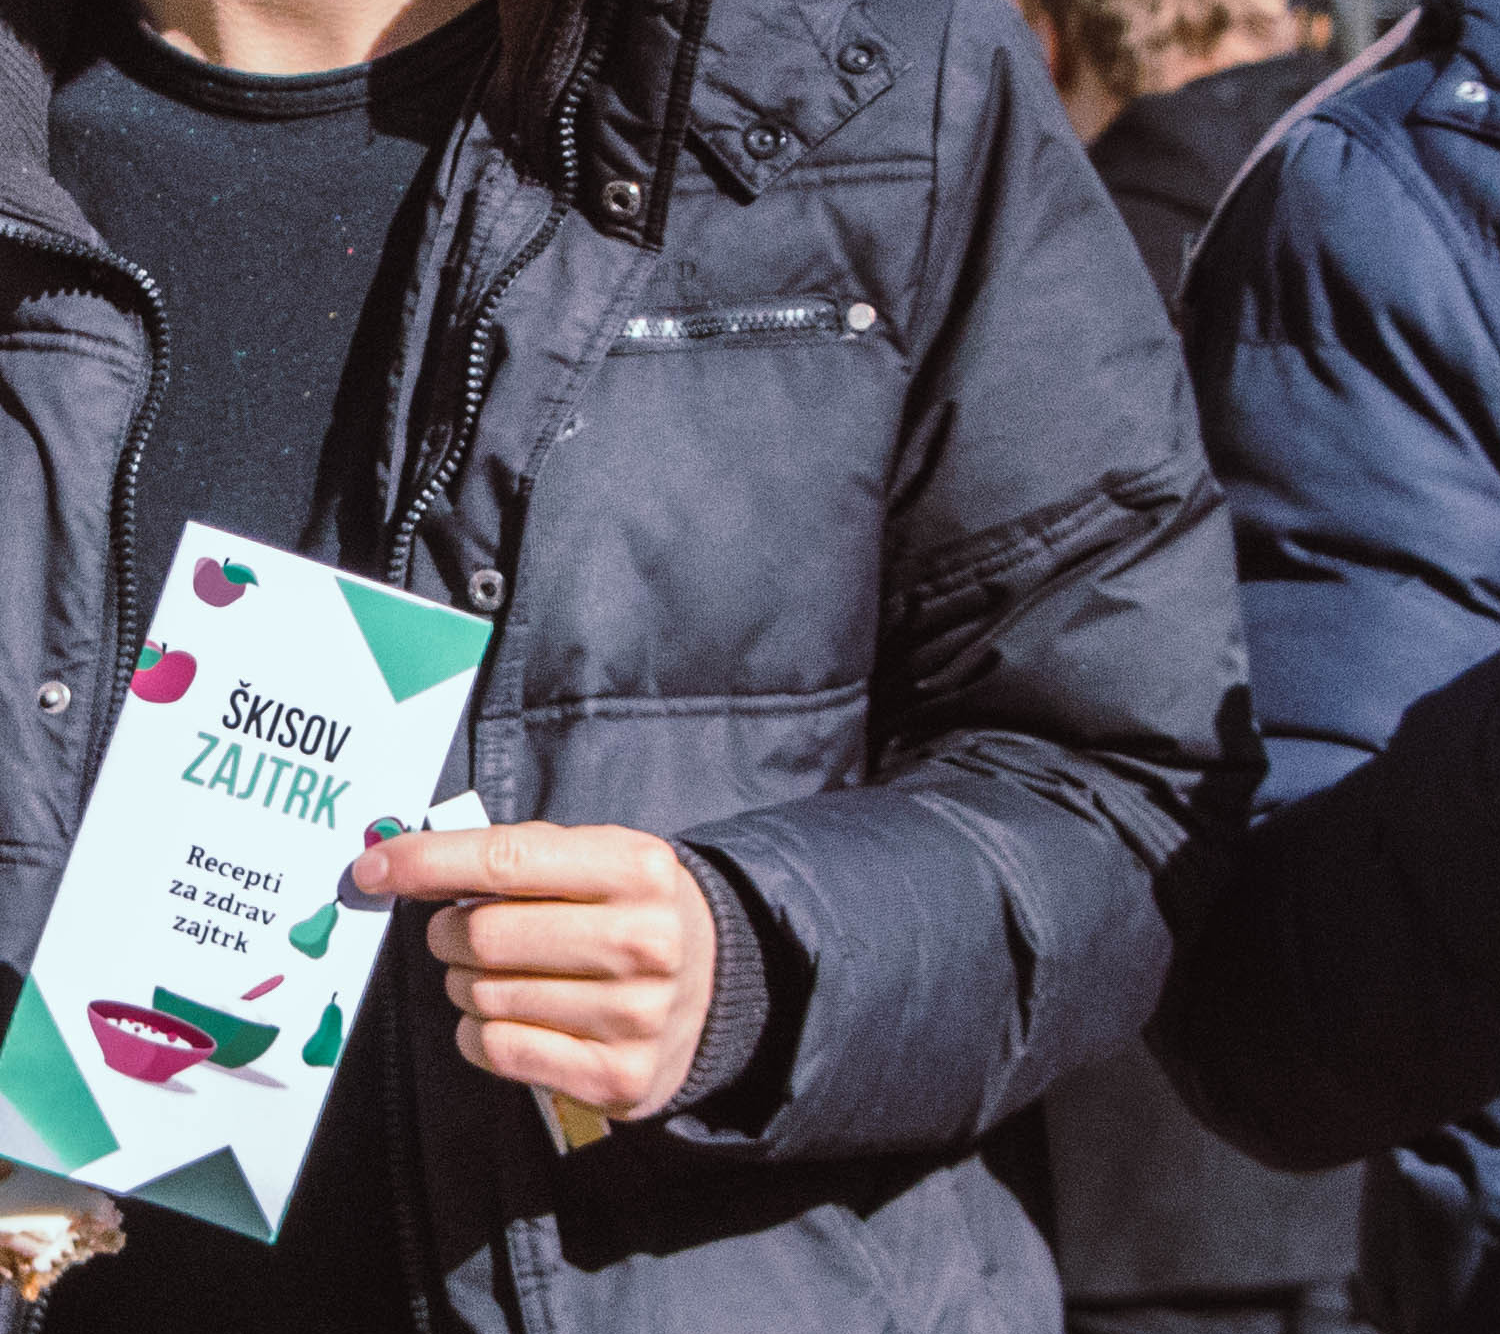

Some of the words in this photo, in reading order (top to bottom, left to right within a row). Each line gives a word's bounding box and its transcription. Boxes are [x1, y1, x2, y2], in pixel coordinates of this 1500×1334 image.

[222, 679, 352, 763] ŠKISOV
[181, 730, 351, 830] ZAJTRK
[186, 845, 284, 894] Recepti
[169, 879, 198, 902] za
[203, 890, 277, 926] zdrav
[172, 915, 249, 954] zajtrk
